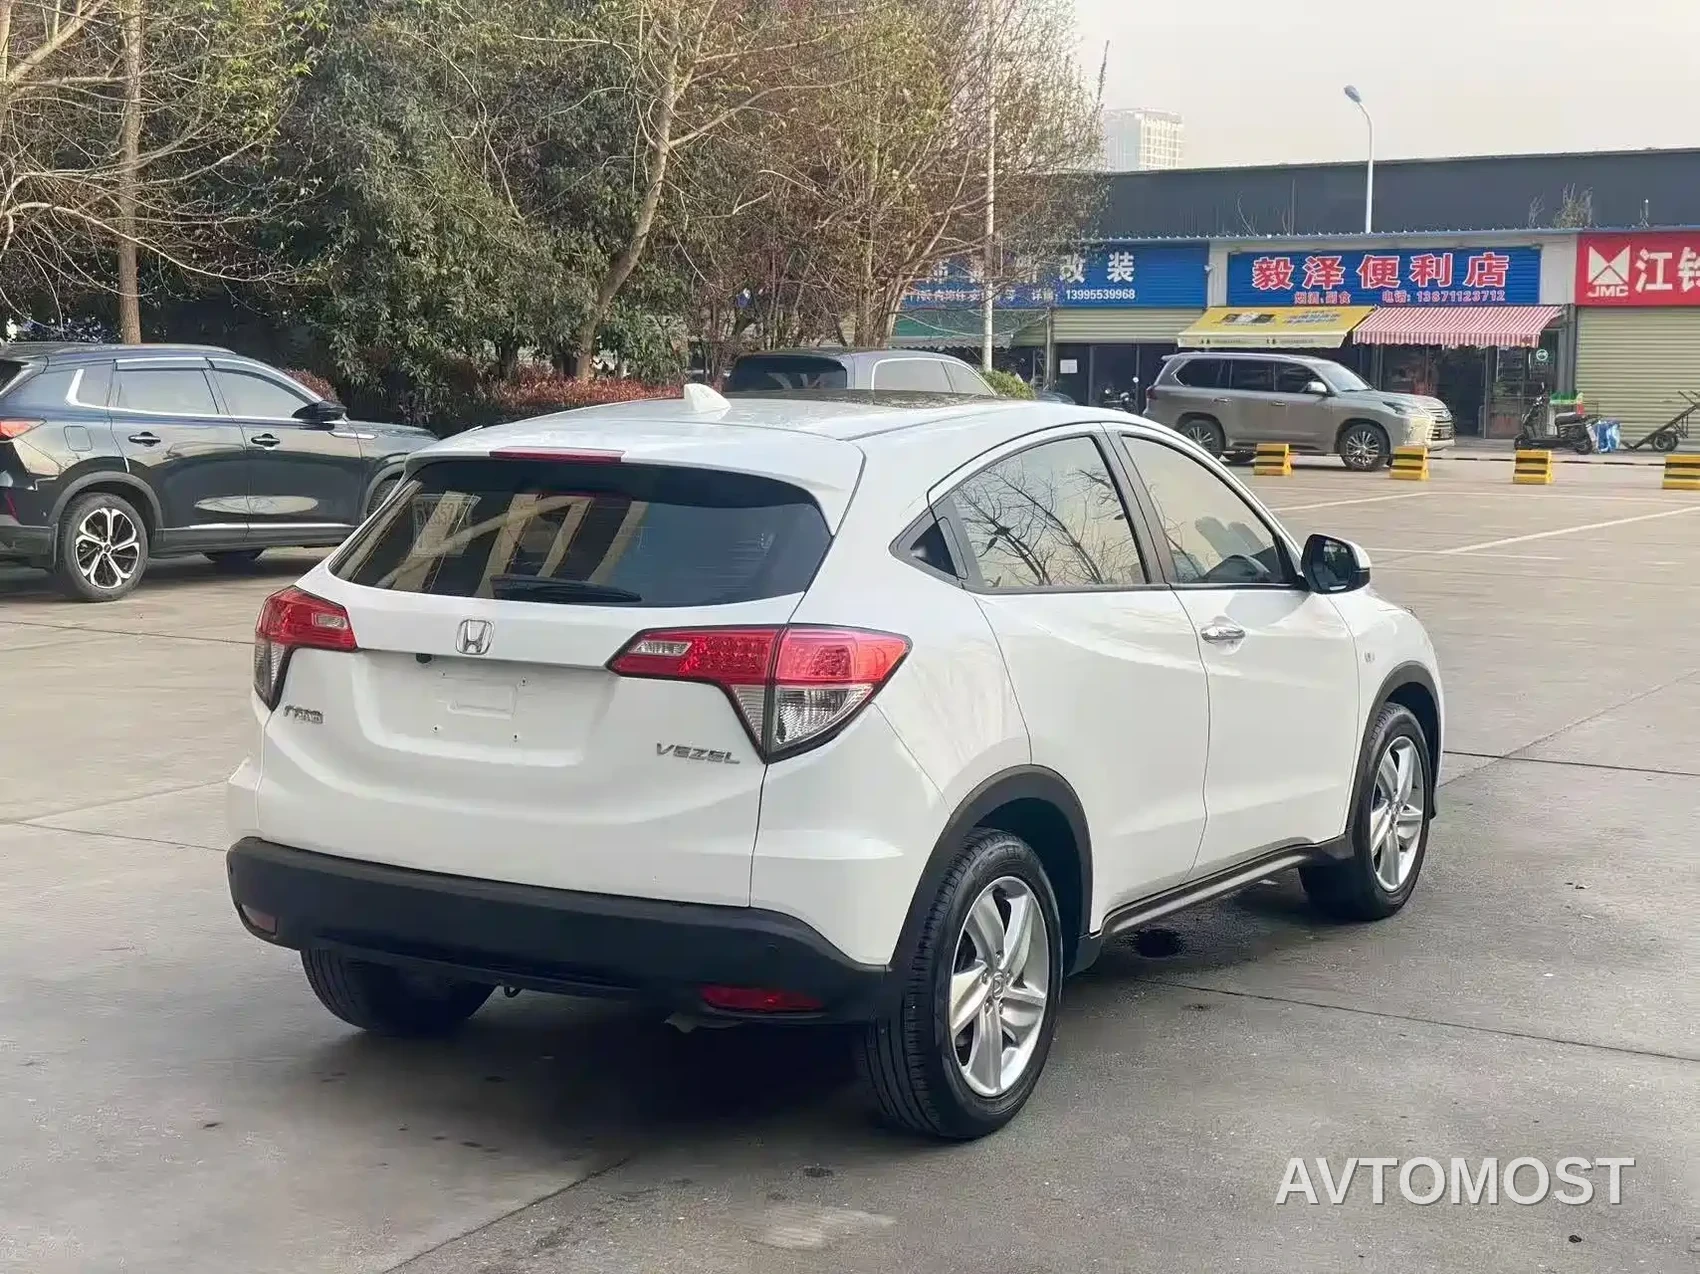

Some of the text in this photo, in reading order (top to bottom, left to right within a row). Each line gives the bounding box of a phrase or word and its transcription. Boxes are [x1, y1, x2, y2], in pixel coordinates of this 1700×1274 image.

[1252, 252, 1510, 290] 毅泽便利店
[1066, 288, 1136, 300] 13995539968
[1587, 285, 1629, 298] JMC
[656, 742, 741, 765] VEZEL
